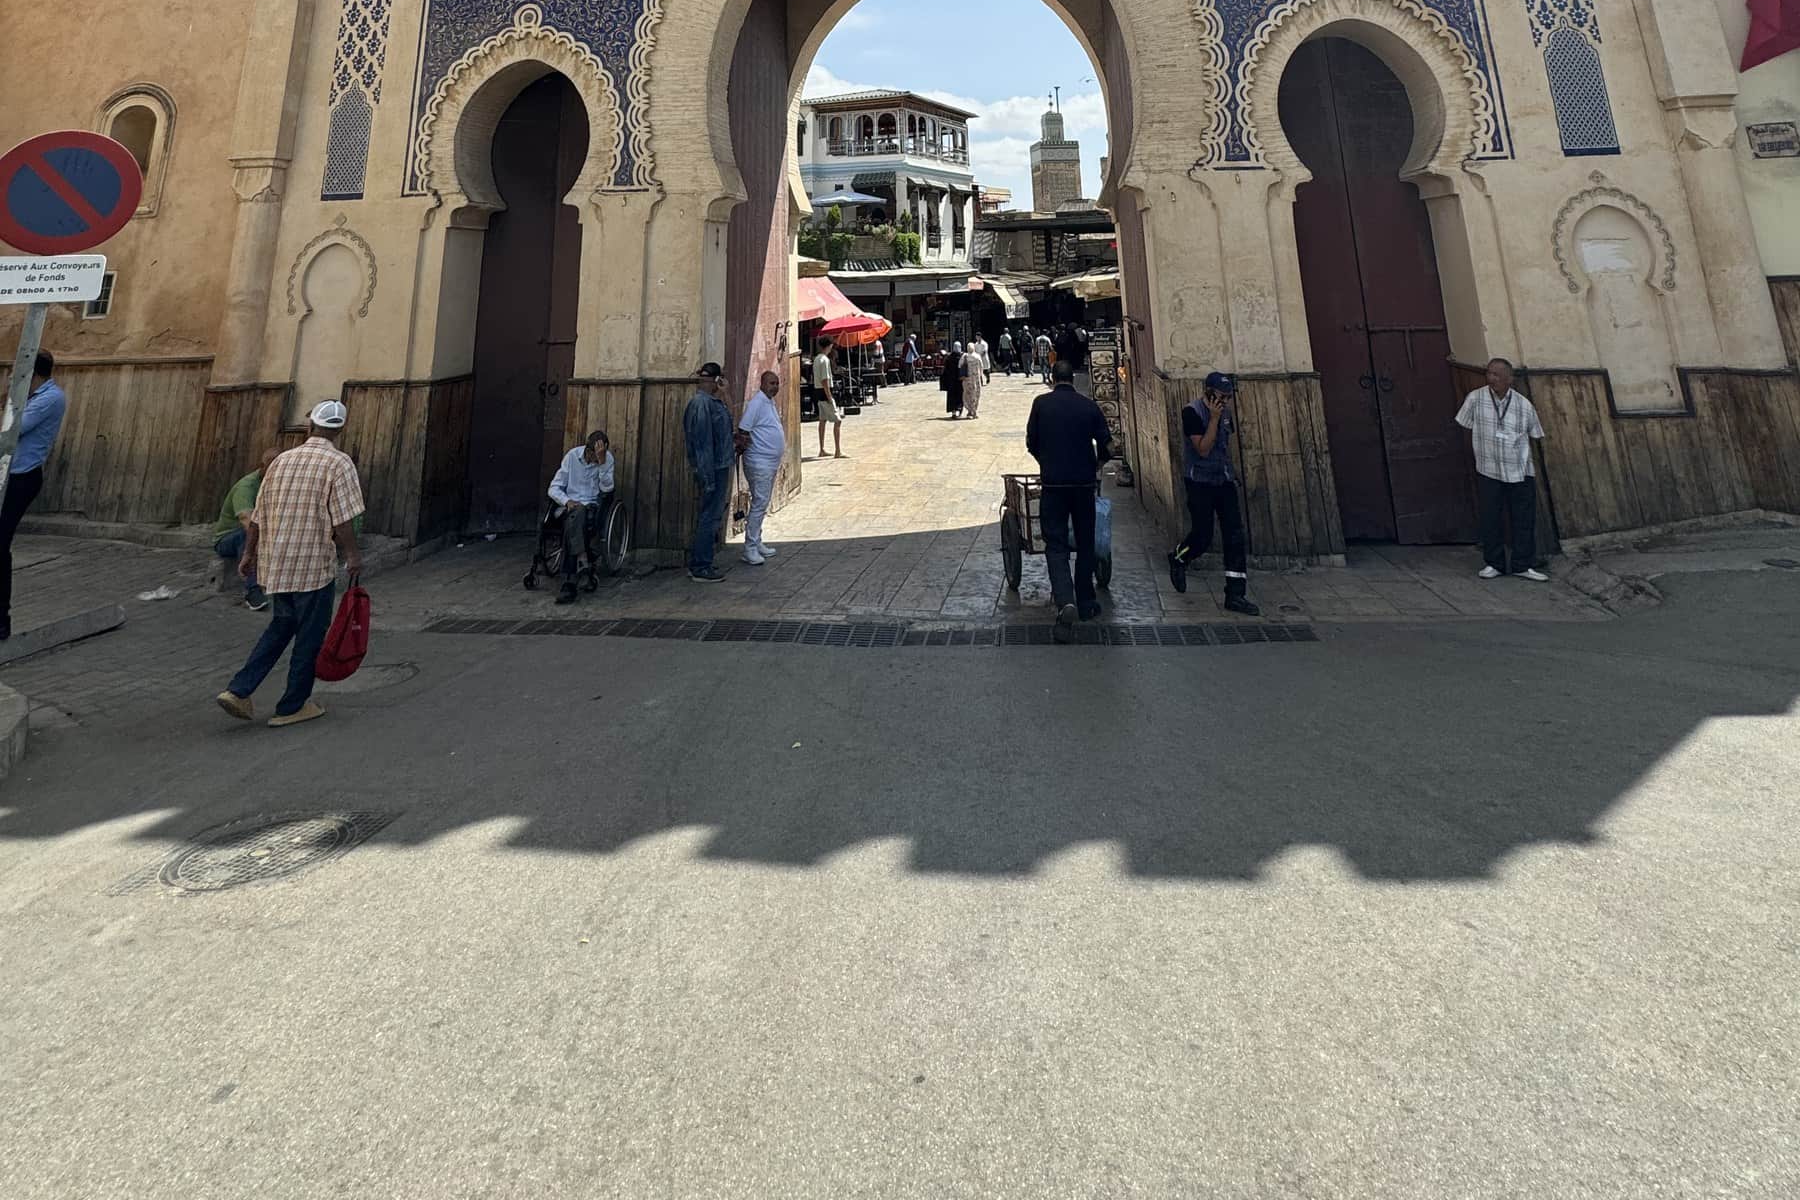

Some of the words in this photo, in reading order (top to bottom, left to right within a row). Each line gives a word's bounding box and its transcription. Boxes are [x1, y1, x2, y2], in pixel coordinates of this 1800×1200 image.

[30, 262, 47, 270] Aux
[25, 274, 36, 282] de
[38, 273, 66, 281] Fonds
